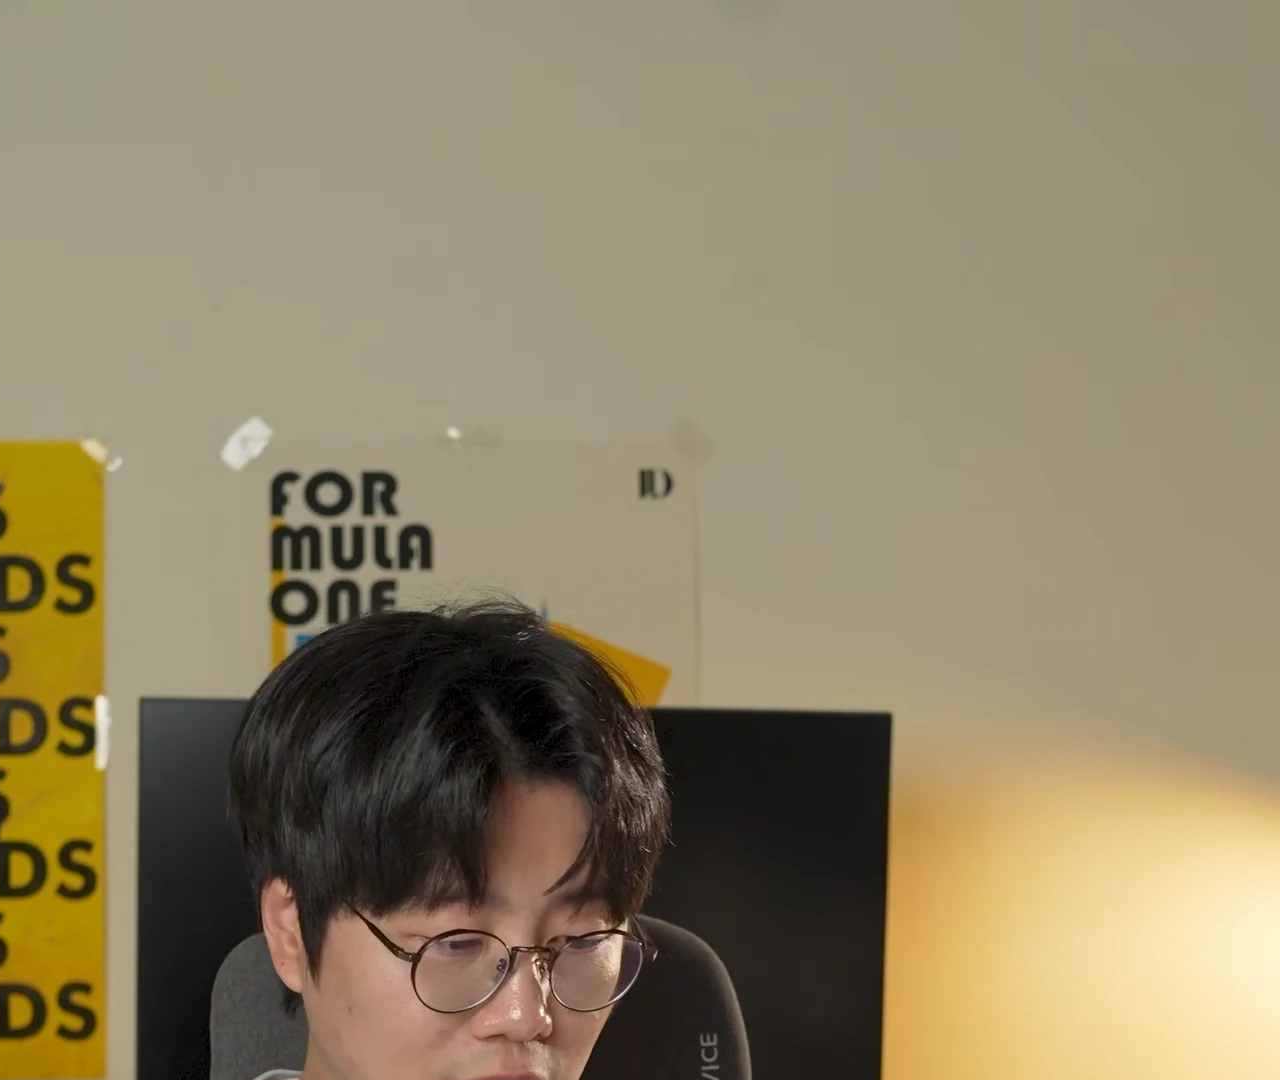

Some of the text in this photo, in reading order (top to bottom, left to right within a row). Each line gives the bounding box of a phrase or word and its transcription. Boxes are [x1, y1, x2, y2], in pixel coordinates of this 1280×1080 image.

[270, 470, 398, 516] FOR
[270, 524, 433, 571] MULA
[269, 579, 398, 626] ONE
